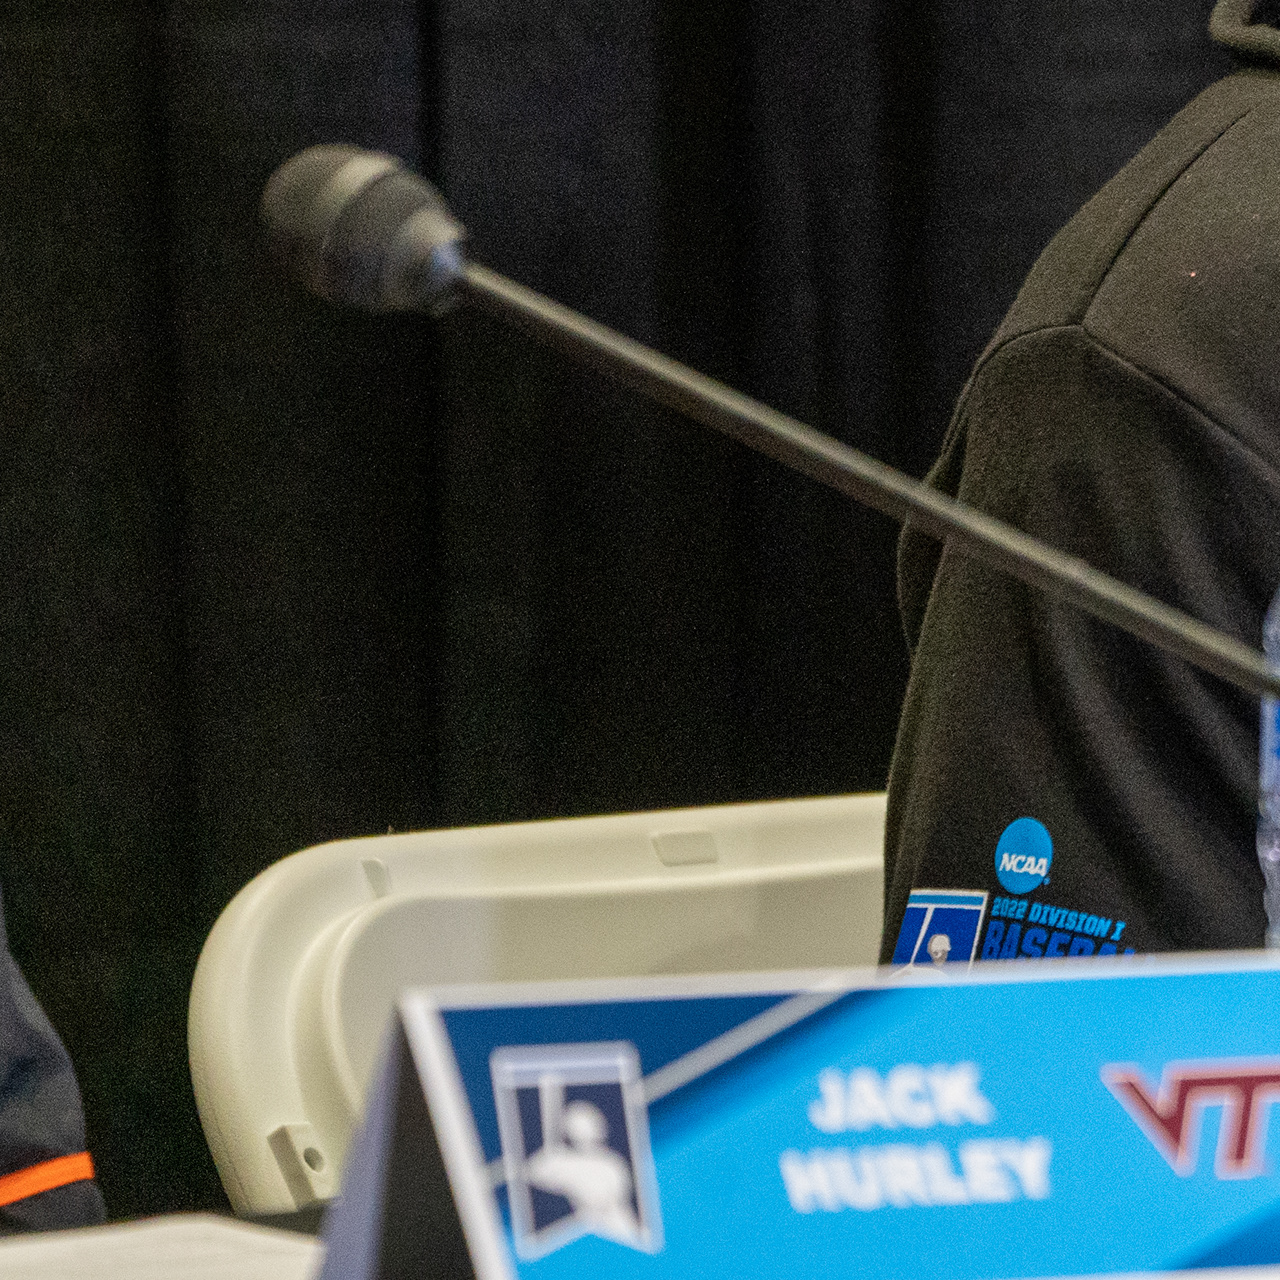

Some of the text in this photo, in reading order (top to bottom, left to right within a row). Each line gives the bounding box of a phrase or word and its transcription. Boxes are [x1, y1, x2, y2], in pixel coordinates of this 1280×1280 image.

[1000, 852, 1048, 877] NCAA
[991, 896, 1029, 920] 2022
[1028, 902, 1112, 938] DIVISION
[807, 1061, 997, 1134] JACK
[779, 1136, 1051, 1214] HURLEY
